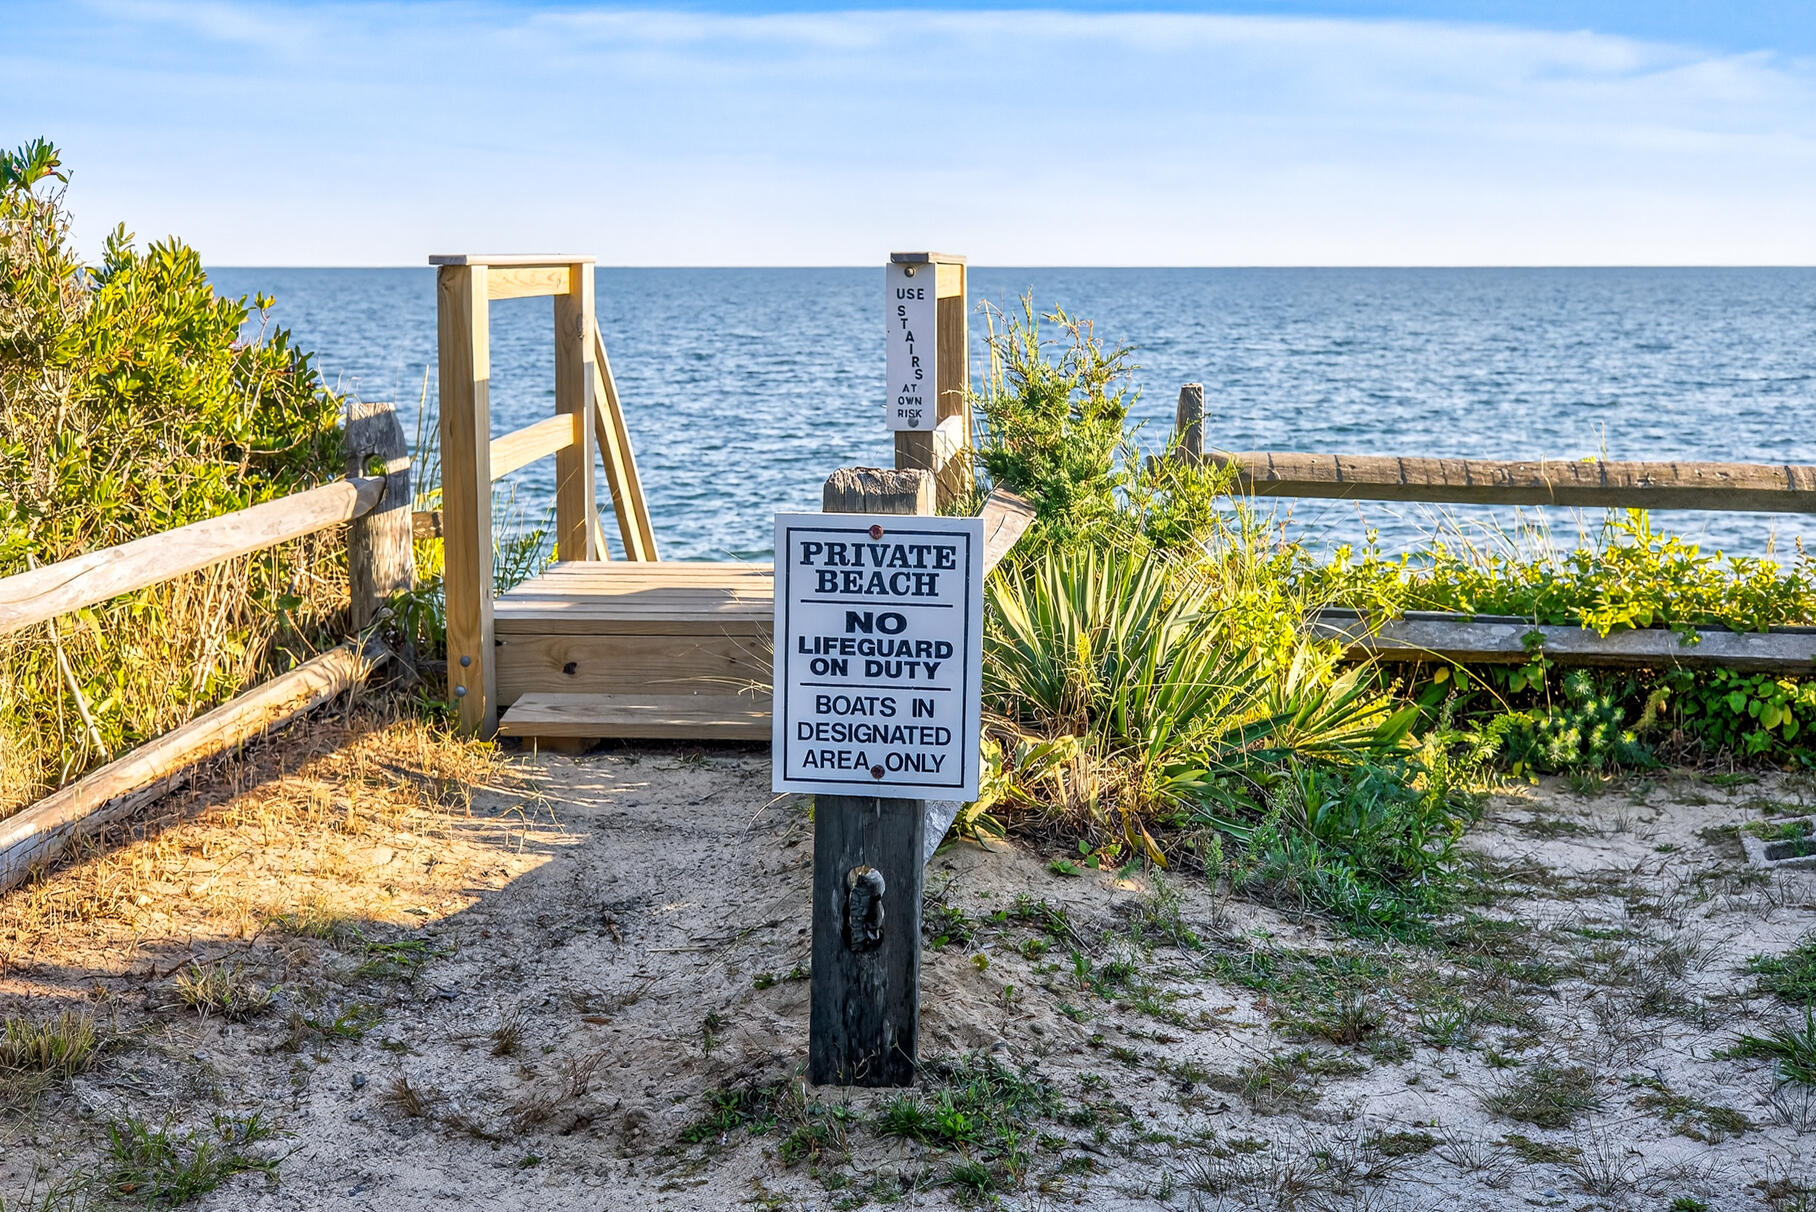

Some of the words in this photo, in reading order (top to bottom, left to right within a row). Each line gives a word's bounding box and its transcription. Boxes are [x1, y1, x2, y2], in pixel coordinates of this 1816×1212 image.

[896, 288, 925, 301] USE
[897, 305, 924, 381] STAIRS
[901, 383, 918, 393] AT
[897, 396, 923, 406] OWN
[897, 408, 923, 419] RISK
[800, 541, 957, 571] PRIVATE
[814, 569, 940, 598] BEACH
[845, 610, 908, 636] NO
[798, 635, 954, 660] LIFEGUARD
[809, 657, 849, 677] ON
[864, 659, 942, 680] DUTY
[815, 694, 897, 718] BOATS
[911, 698, 935, 719] IN
[797, 721, 952, 746] DESIGNATED
[801, 749, 871, 771] AREA
[884, 751, 947, 774] ONLY
